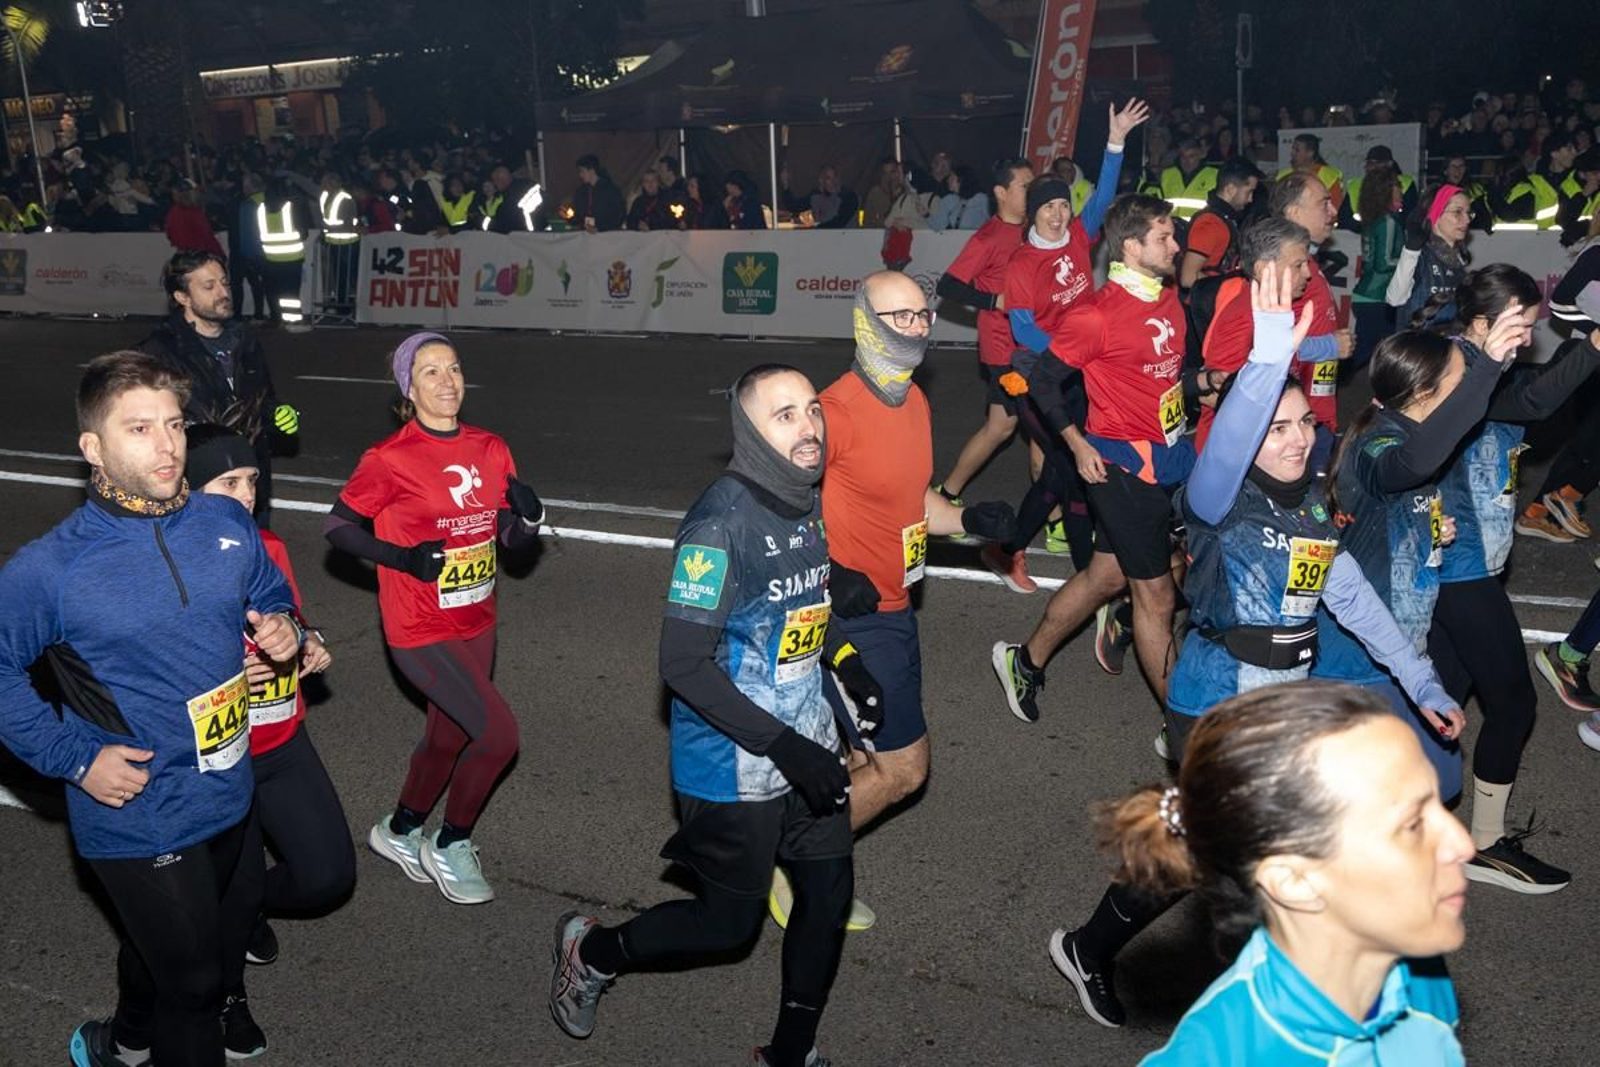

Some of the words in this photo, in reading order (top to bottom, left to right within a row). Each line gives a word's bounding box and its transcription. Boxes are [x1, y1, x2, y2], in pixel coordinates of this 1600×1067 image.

[371, 246, 405, 275] 42
[408, 247, 462, 278] SAN
[796, 275, 861, 291] calder
[1307, 543, 1321, 558] 42
[688, 582, 716, 596] RURAL
[799, 610, 813, 624] 42
[785, 623, 827, 655] 347
[209, 690, 227, 708] 42
[205, 695, 248, 741] 442
